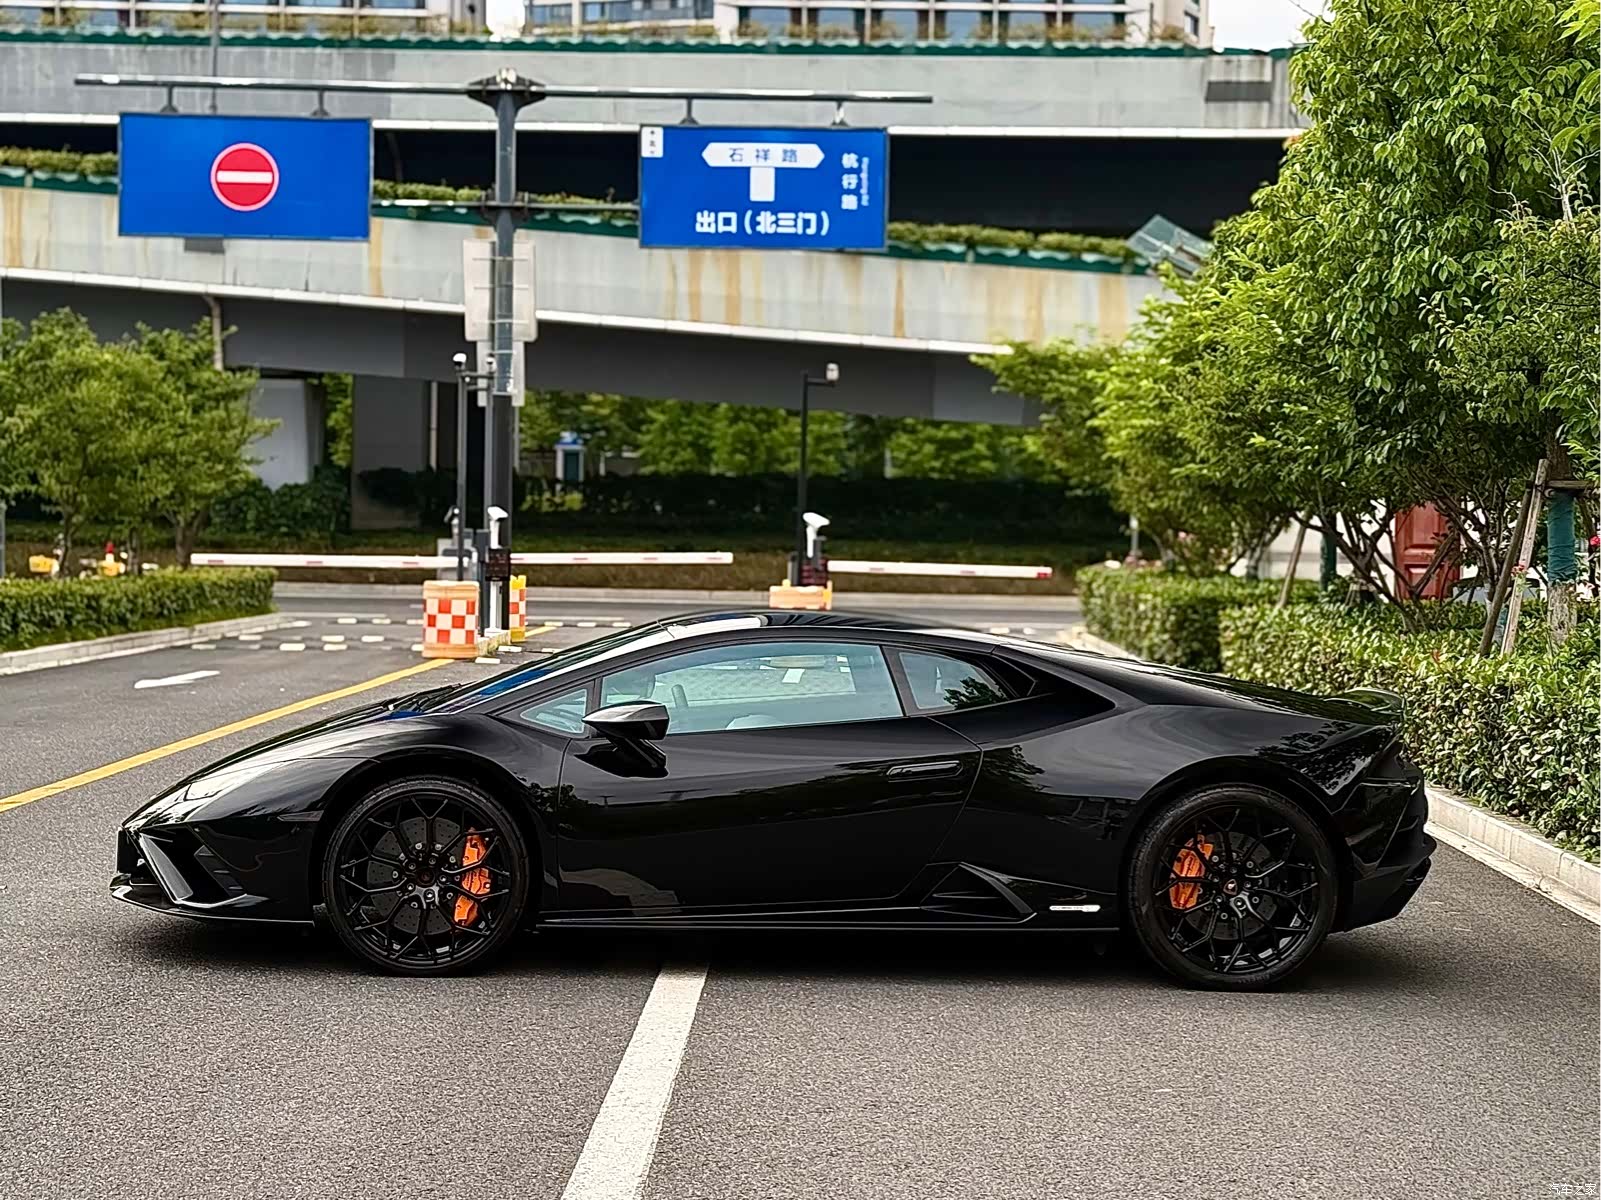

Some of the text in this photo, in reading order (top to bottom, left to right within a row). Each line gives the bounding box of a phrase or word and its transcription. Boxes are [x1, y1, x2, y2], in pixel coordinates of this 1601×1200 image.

[728, 147, 798, 163] 石祥路
[695, 209, 830, 236] 出口（北三门）
